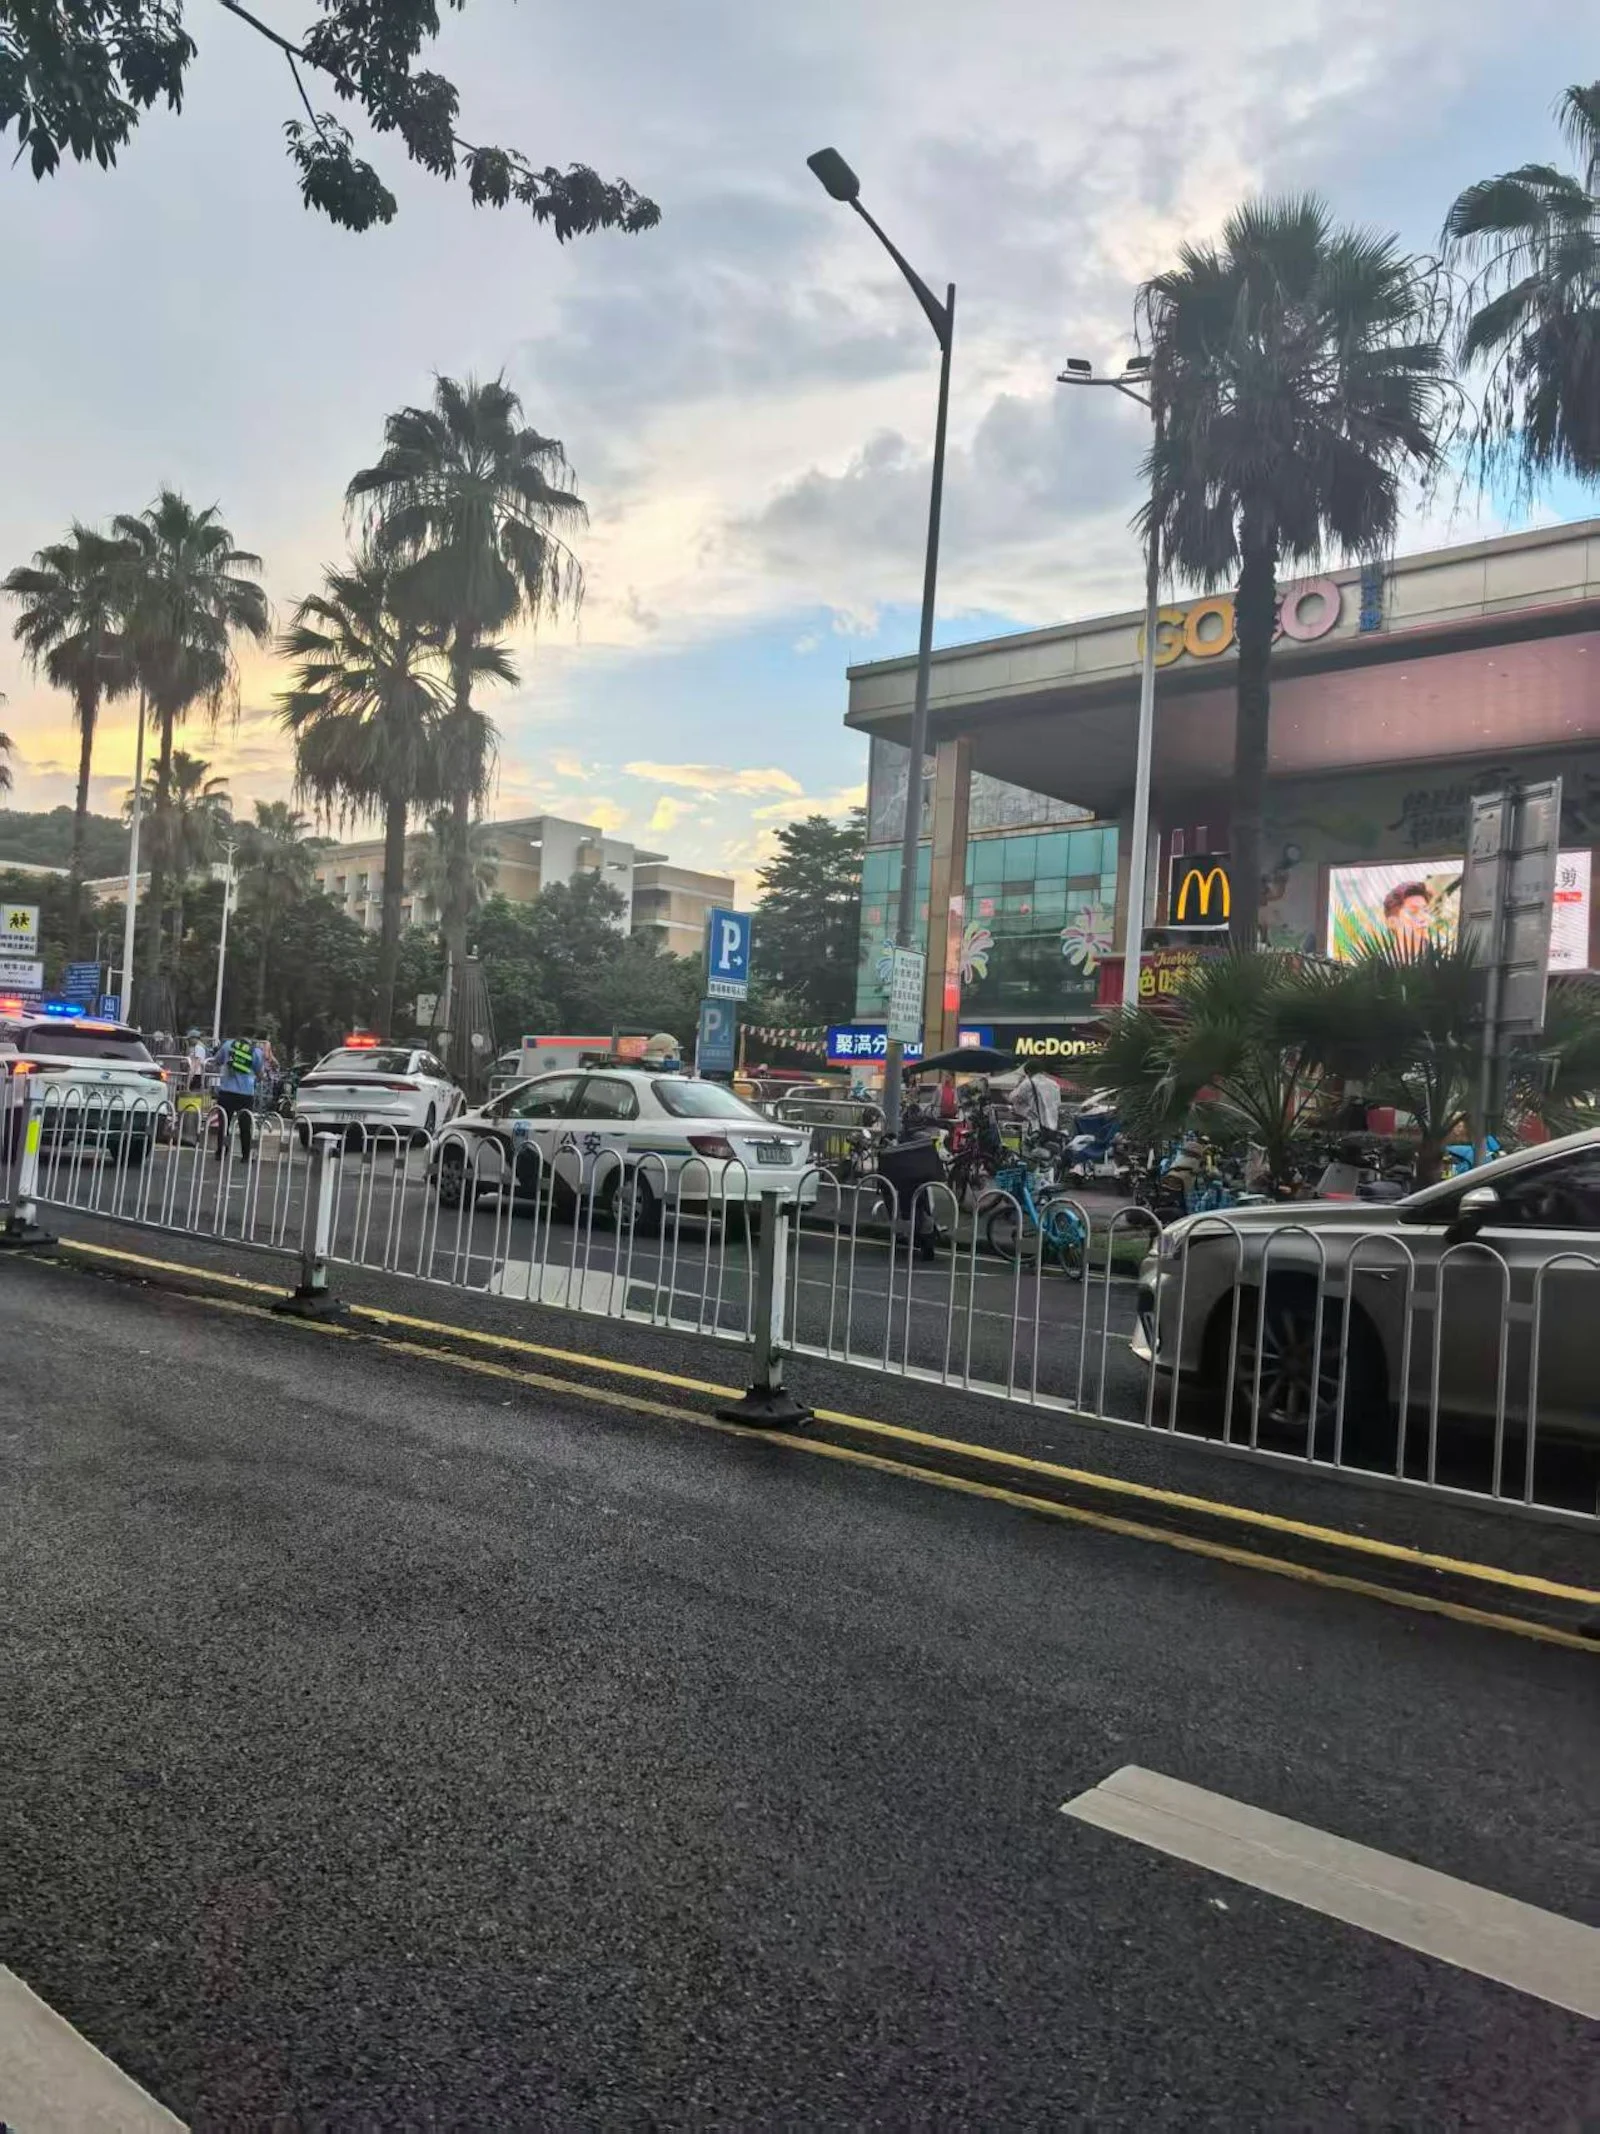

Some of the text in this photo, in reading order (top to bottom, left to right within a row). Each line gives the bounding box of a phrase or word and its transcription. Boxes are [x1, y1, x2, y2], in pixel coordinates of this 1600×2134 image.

[1138, 578, 1341, 668] GOO
[719, 919, 741, 970] P
[104, 998, 115, 1022] 出口
[703, 1008, 722, 1043] P
[835, 1033, 887, 1055] 聚满分
[1015, 1036, 1104, 1056] McDon
[560, 1131, 601, 1156] 公安
